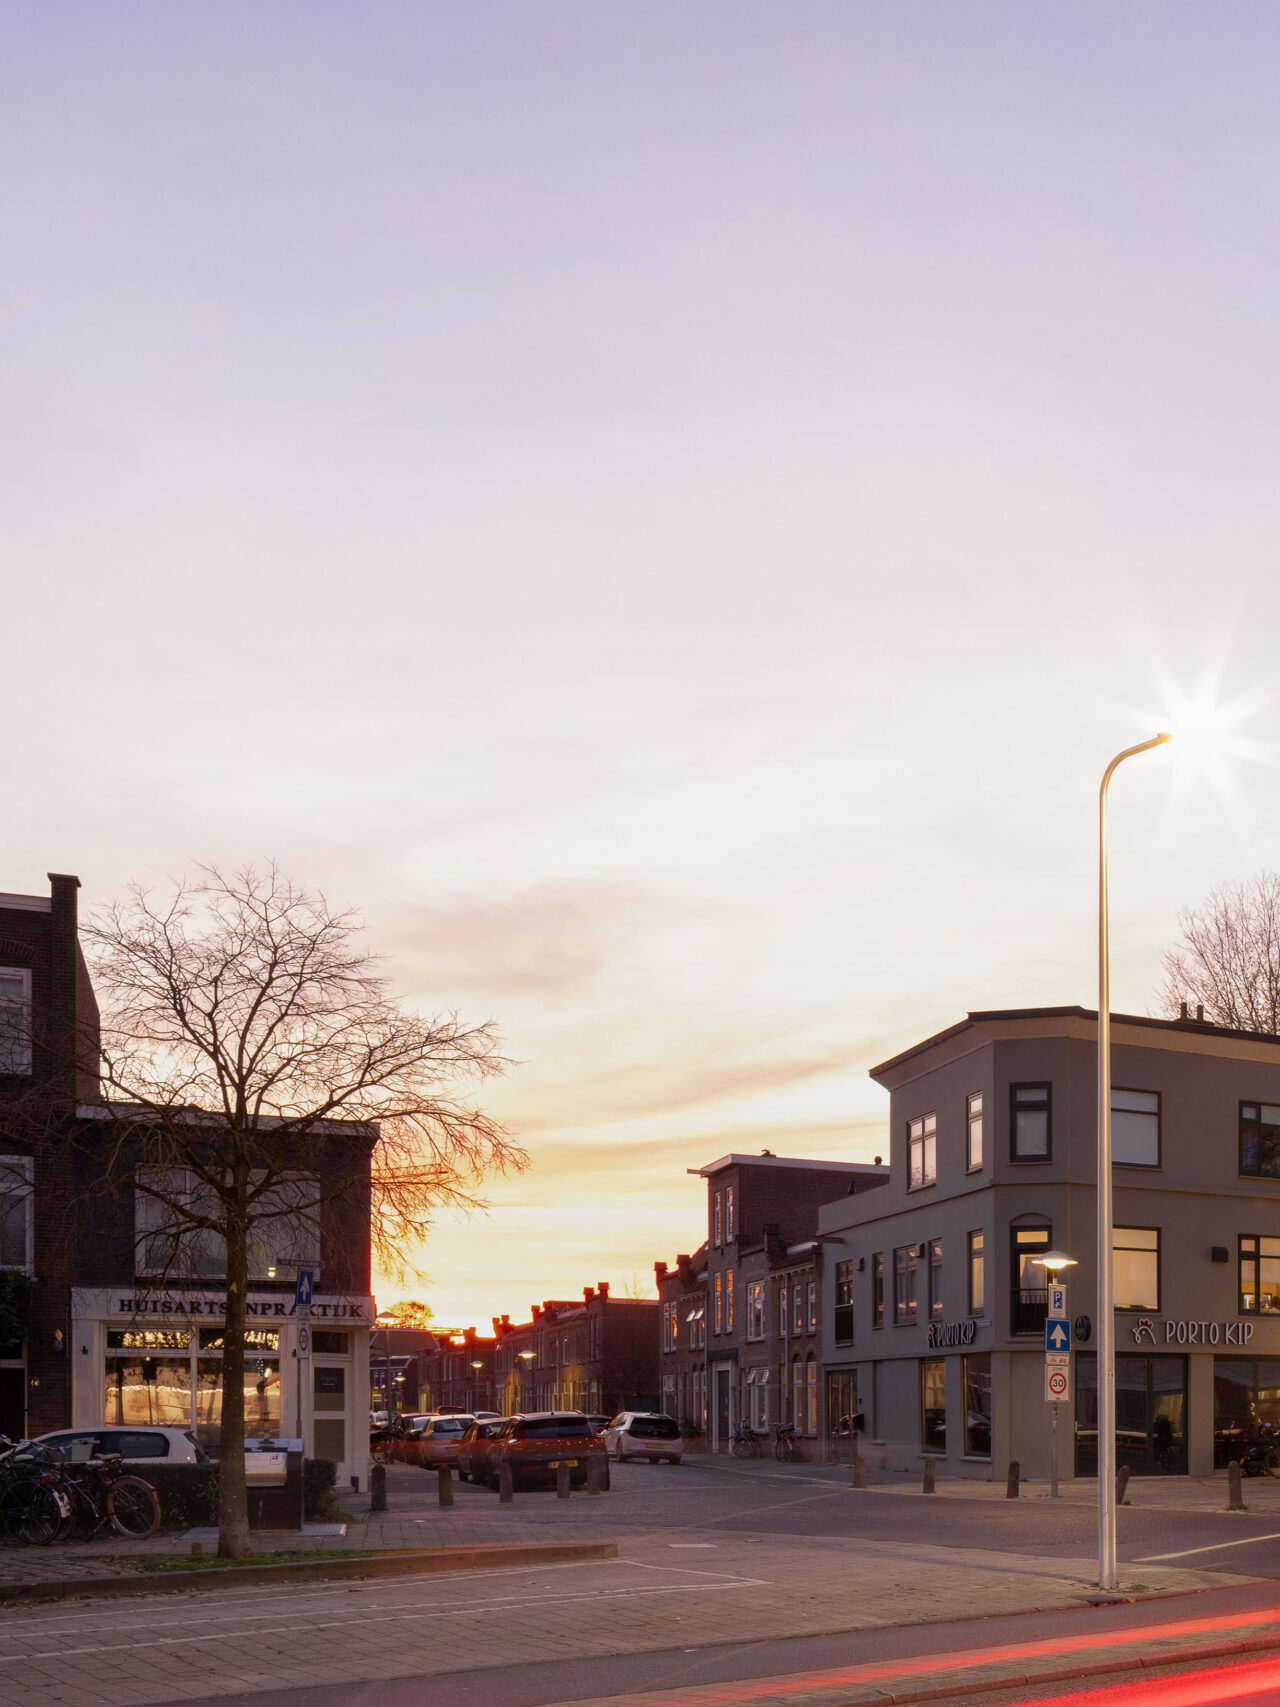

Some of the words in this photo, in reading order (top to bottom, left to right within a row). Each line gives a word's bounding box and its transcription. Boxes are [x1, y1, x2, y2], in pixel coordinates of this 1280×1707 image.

[118, 1299, 363, 1317] HUISARTSNPRAKTIJK
[937, 1323, 960, 1347] PORTO
[960, 1320, 975, 1344] KIP
[1164, 1320, 1220, 1345] PORTO
[1225, 1321, 1255, 1346] KIP
[1052, 1379, 1064, 1387] 30
